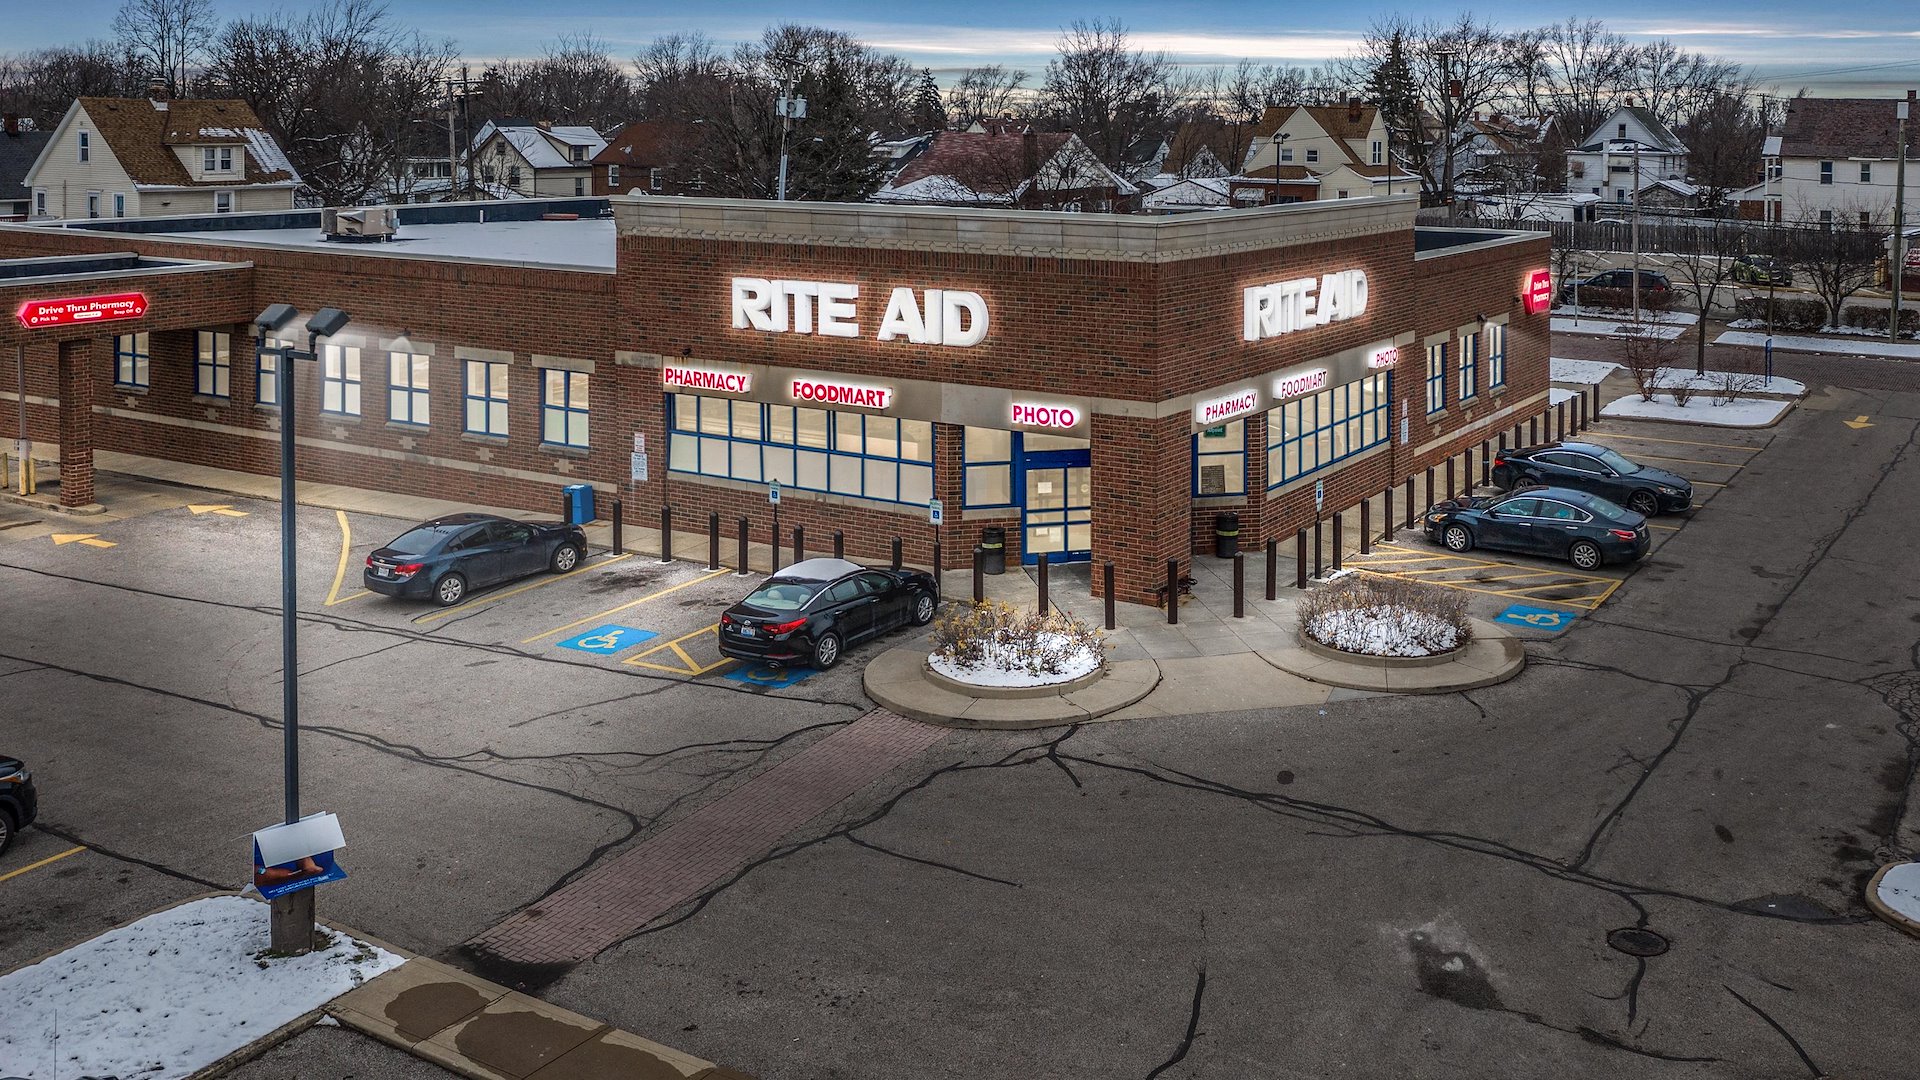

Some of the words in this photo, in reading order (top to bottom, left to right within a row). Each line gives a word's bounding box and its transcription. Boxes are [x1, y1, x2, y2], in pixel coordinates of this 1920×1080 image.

[38, 306, 64, 315] Drive
[66, 304, 88, 313] Thru
[90, 301, 134, 311] Pharmacy
[732, 277, 859, 337] RITE
[877, 287, 989, 347] AID
[1243, 278, 1317, 341] RITE
[1316, 269, 1368, 324] AID
[1376, 349, 1398, 366] PHOTO
[665, 368, 746, 392] PHARMACY
[1281, 371, 1327, 398] FOODMART
[793, 382, 885, 407] FOODMART
[1205, 392, 1257, 421] PHARMACY
[1013, 405, 1075, 427] PHOTO
